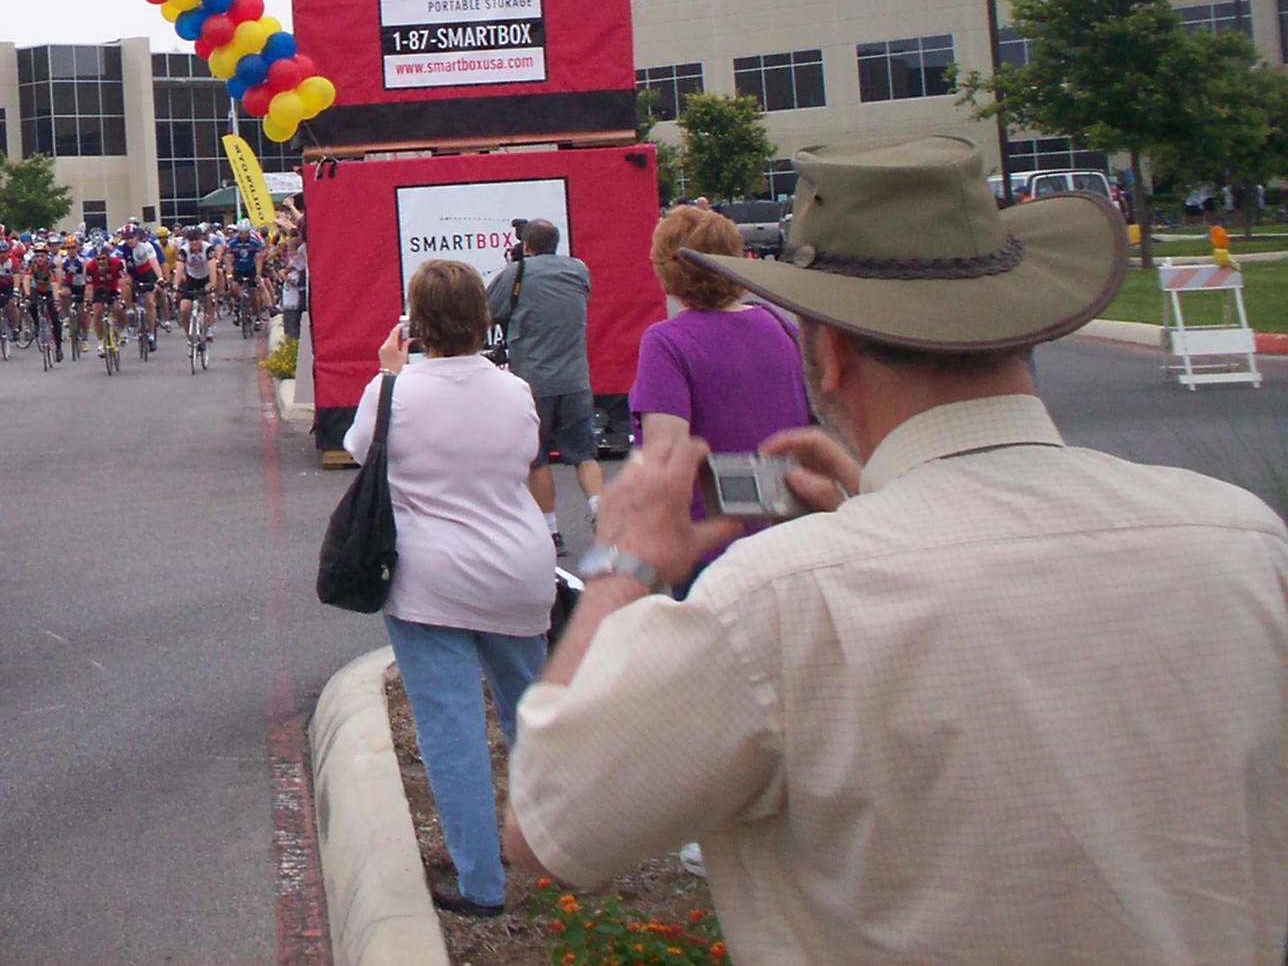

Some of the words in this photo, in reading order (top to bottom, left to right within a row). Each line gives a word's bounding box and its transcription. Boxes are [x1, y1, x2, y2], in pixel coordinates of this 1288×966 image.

[393, 23, 532, 51] 1-87-SMARTBOX
[395, 55, 533, 75] www.smartboxusa.com
[410, 232, 513, 253] SMARTBOX
